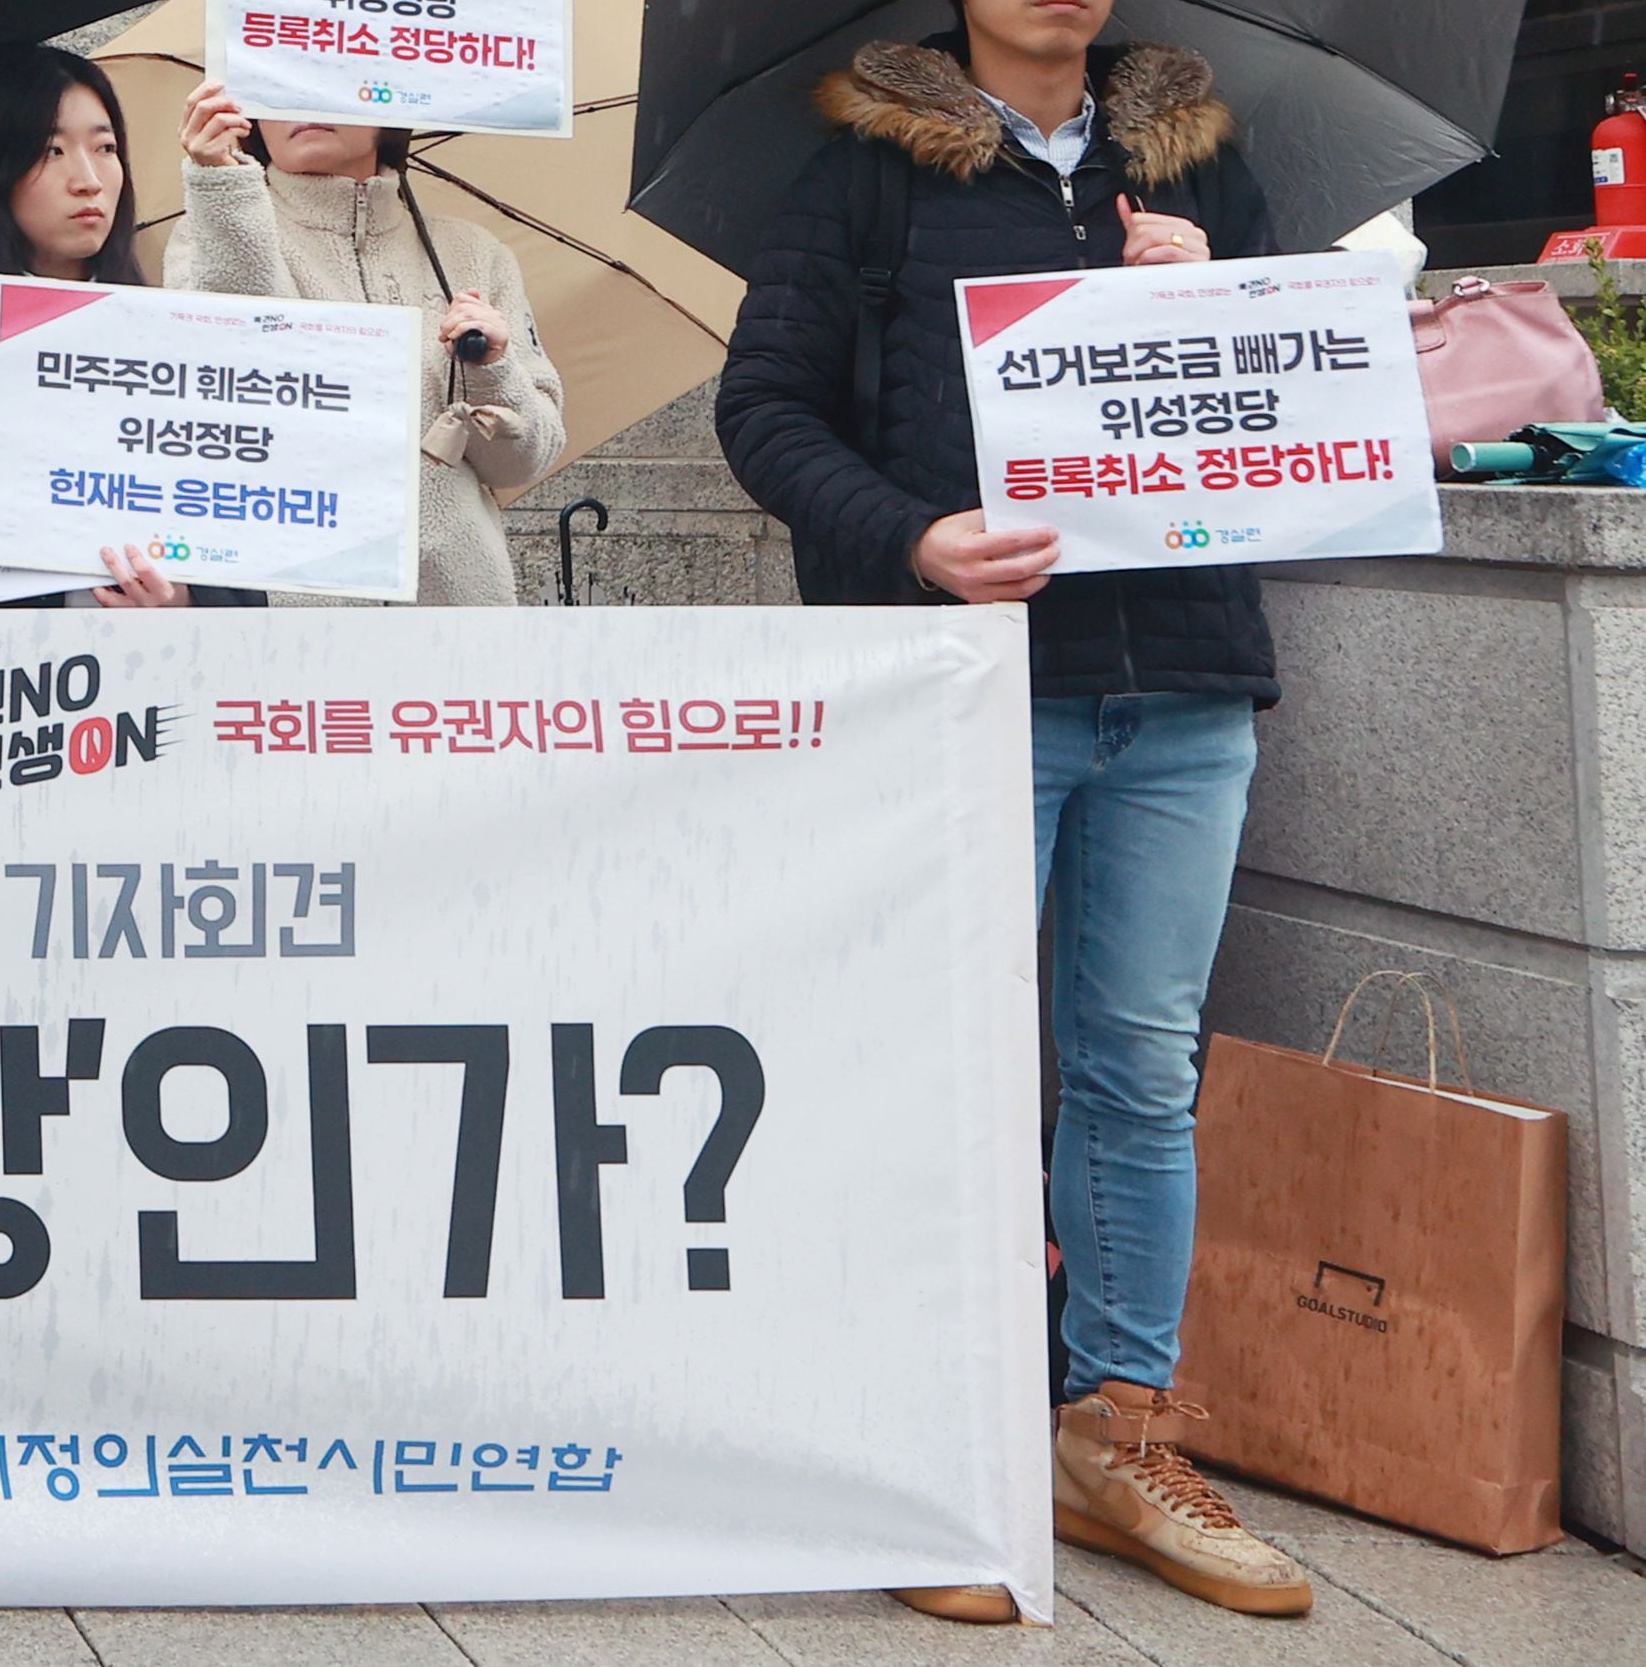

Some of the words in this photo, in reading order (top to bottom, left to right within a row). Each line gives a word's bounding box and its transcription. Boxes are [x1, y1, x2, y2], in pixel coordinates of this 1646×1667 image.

[242, 12, 380, 56] 등록취소
[389, 26, 536, 71] 정당하다!
[37, 351, 187, 399] 민주주의
[196, 364, 351, 412] 훼손하는
[997, 336, 1222, 391] 선거보조금
[1232, 328, 1370, 375] 빼가는
[117, 417, 274, 463] 위성정당
[1100, 388, 1280, 440] 위성정당
[49, 468, 164, 514] 헌재는
[172, 479, 338, 528] 응답하라!
[1003, 452, 1186, 501] 등록취소
[1196, 439, 1394, 491] 정당하다!
[213, 699, 374, 754] 국회를
[389, 699, 604, 754] 유권자의
[619, 698, 824, 753] 힘으로!!
[4, 860, 356, 959] 기자회견
[1297, 1295, 1387, 1333] GOALSTUDIO
